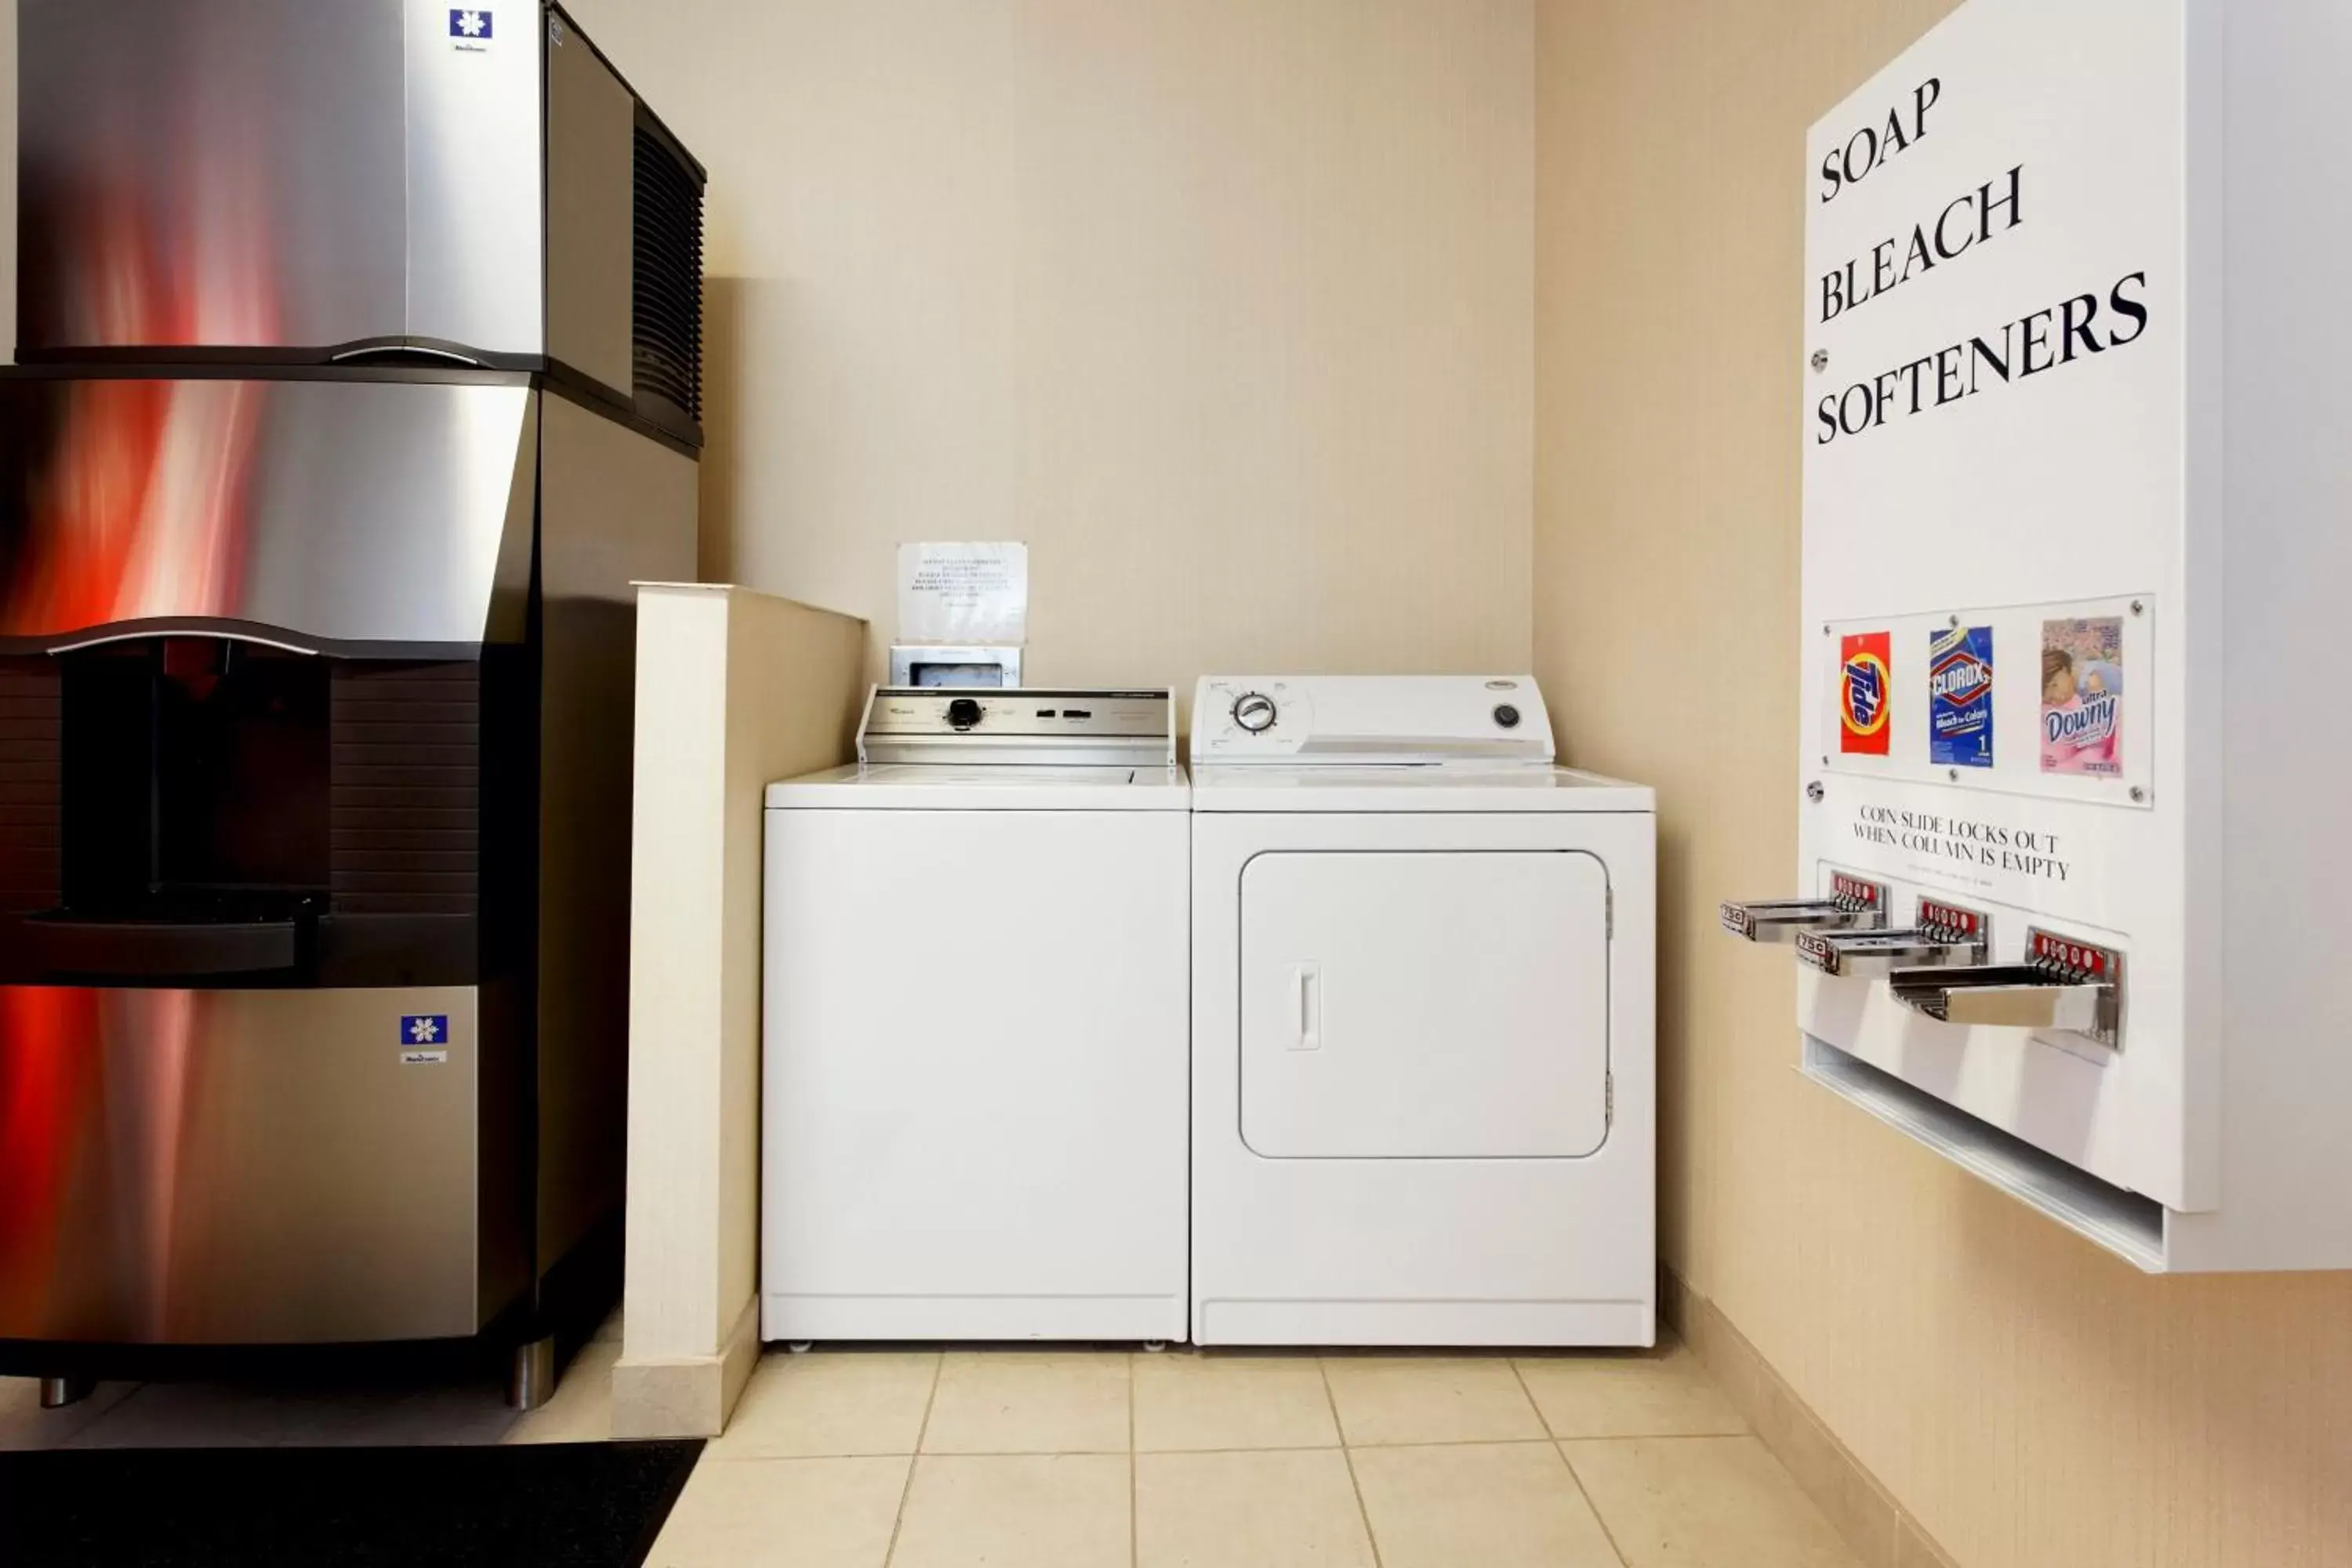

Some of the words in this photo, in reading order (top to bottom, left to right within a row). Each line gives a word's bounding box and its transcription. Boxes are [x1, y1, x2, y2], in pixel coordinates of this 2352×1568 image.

[1821, 77, 1941, 203] SOAP
[1820, 163, 2025, 324] BLEACH
[1817, 271, 2148, 445] SOFTENERS
[1846, 660, 1880, 728] Tide
[1933, 662, 1984, 695] CLOROX
[2045, 697, 2116, 742] Downy
[1853, 822, 1897, 845] WHEN
[1901, 831, 1974, 862] COLUMN
[1980, 847, 1996, 866] IS
[2002, 851, 2070, 881] EMPTY
[1860, 804, 1897, 825] COIN
[1901, 811, 1944, 834] SLIDE
[1949, 818, 2009, 846] LOCKS
[2015, 829, 2059, 855] OUT
